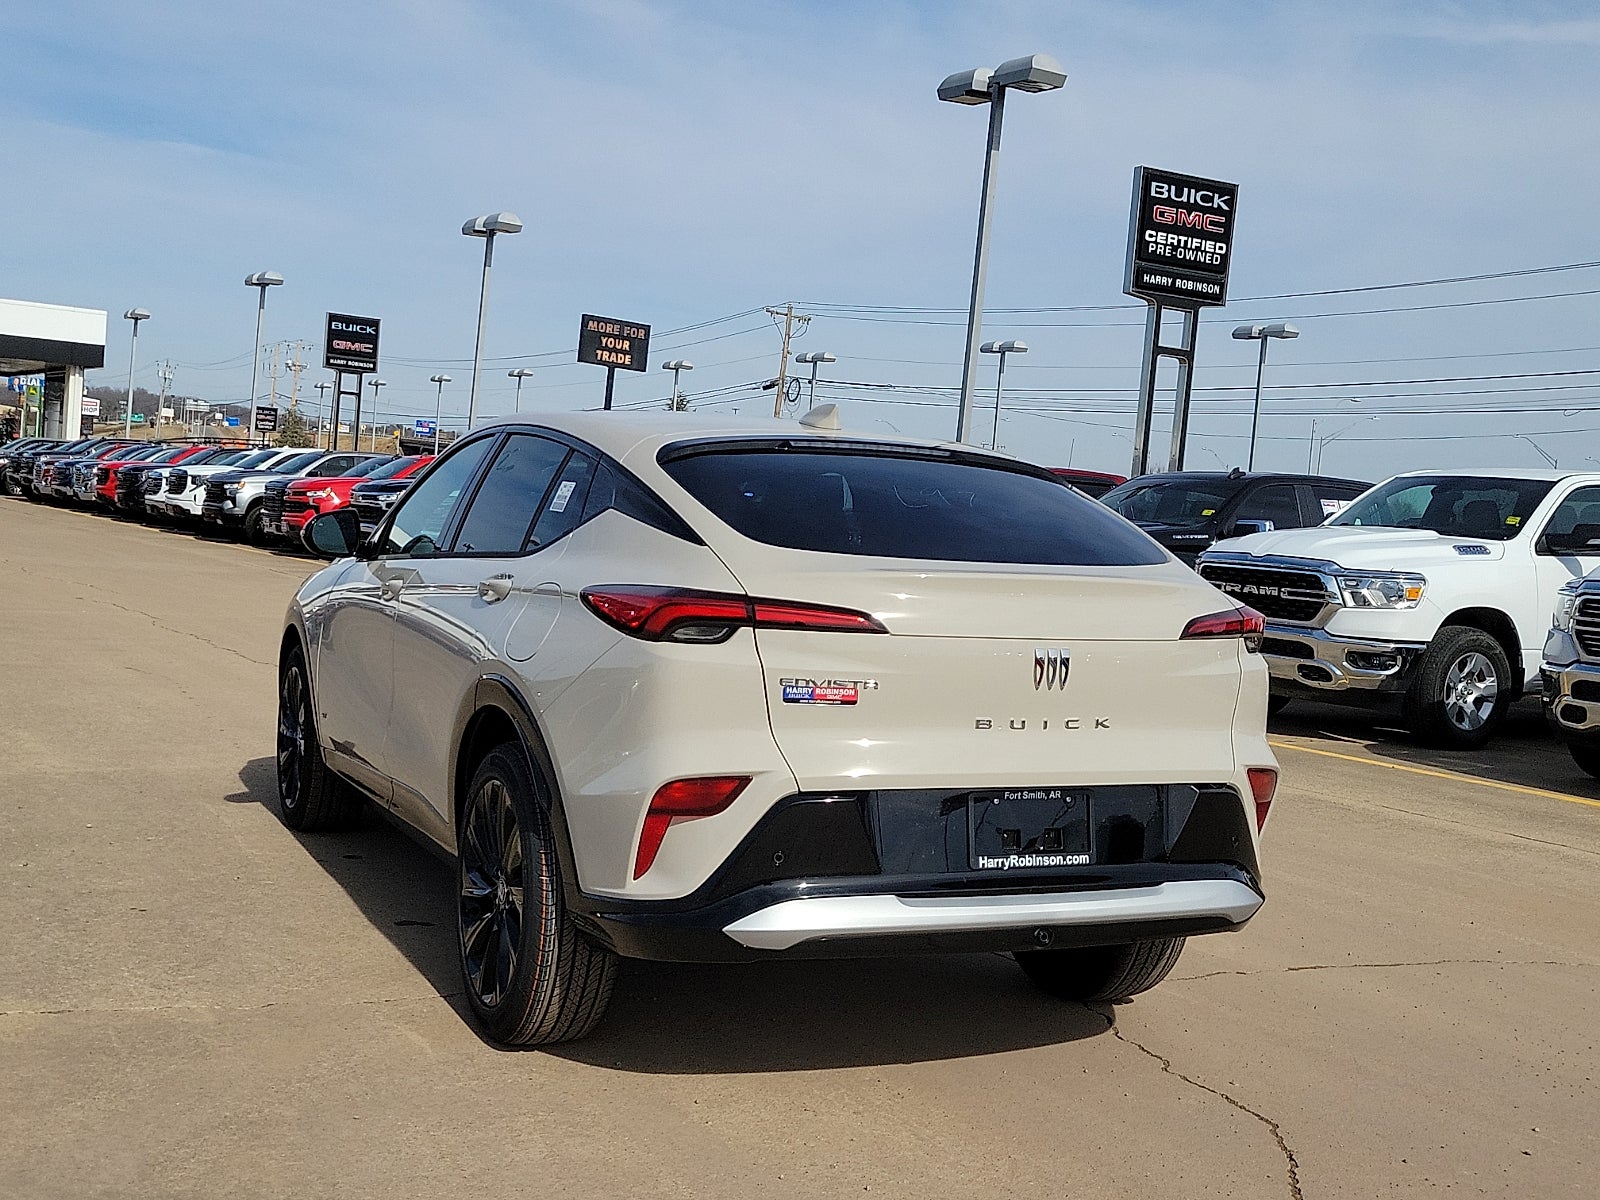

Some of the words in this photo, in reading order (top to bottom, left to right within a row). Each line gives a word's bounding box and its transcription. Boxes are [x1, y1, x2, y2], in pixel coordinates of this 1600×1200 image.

[1151, 182, 1231, 210] BUICK
[1153, 205, 1226, 234] GMC
[1144, 229, 1227, 255] CERTIFIED
[1148, 242, 1221, 265] PRE-OWNED
[1143, 274, 1173, 288] HARRY
[1175, 278, 1220, 295] ROBINSON
[331, 322, 376, 334] BUICK
[588, 321, 620, 335] MORE
[624, 326, 645, 339] FOR
[333, 340, 373, 352] GMC
[601, 337, 630, 351] YOUR
[596, 350, 631, 364] TRADE
[1225, 583, 1278, 595] RAM
[786, 686, 813, 694] HARRY
[815, 687, 856, 696] ROBINSON
[975, 718, 1111, 730] BUICK
[1004, 791, 1021, 800] Fort
[1022, 791, 1048, 800] Smith,
[1049, 790, 1061, 799] AR
[979, 854, 1090, 870] HarryRobinson.com
